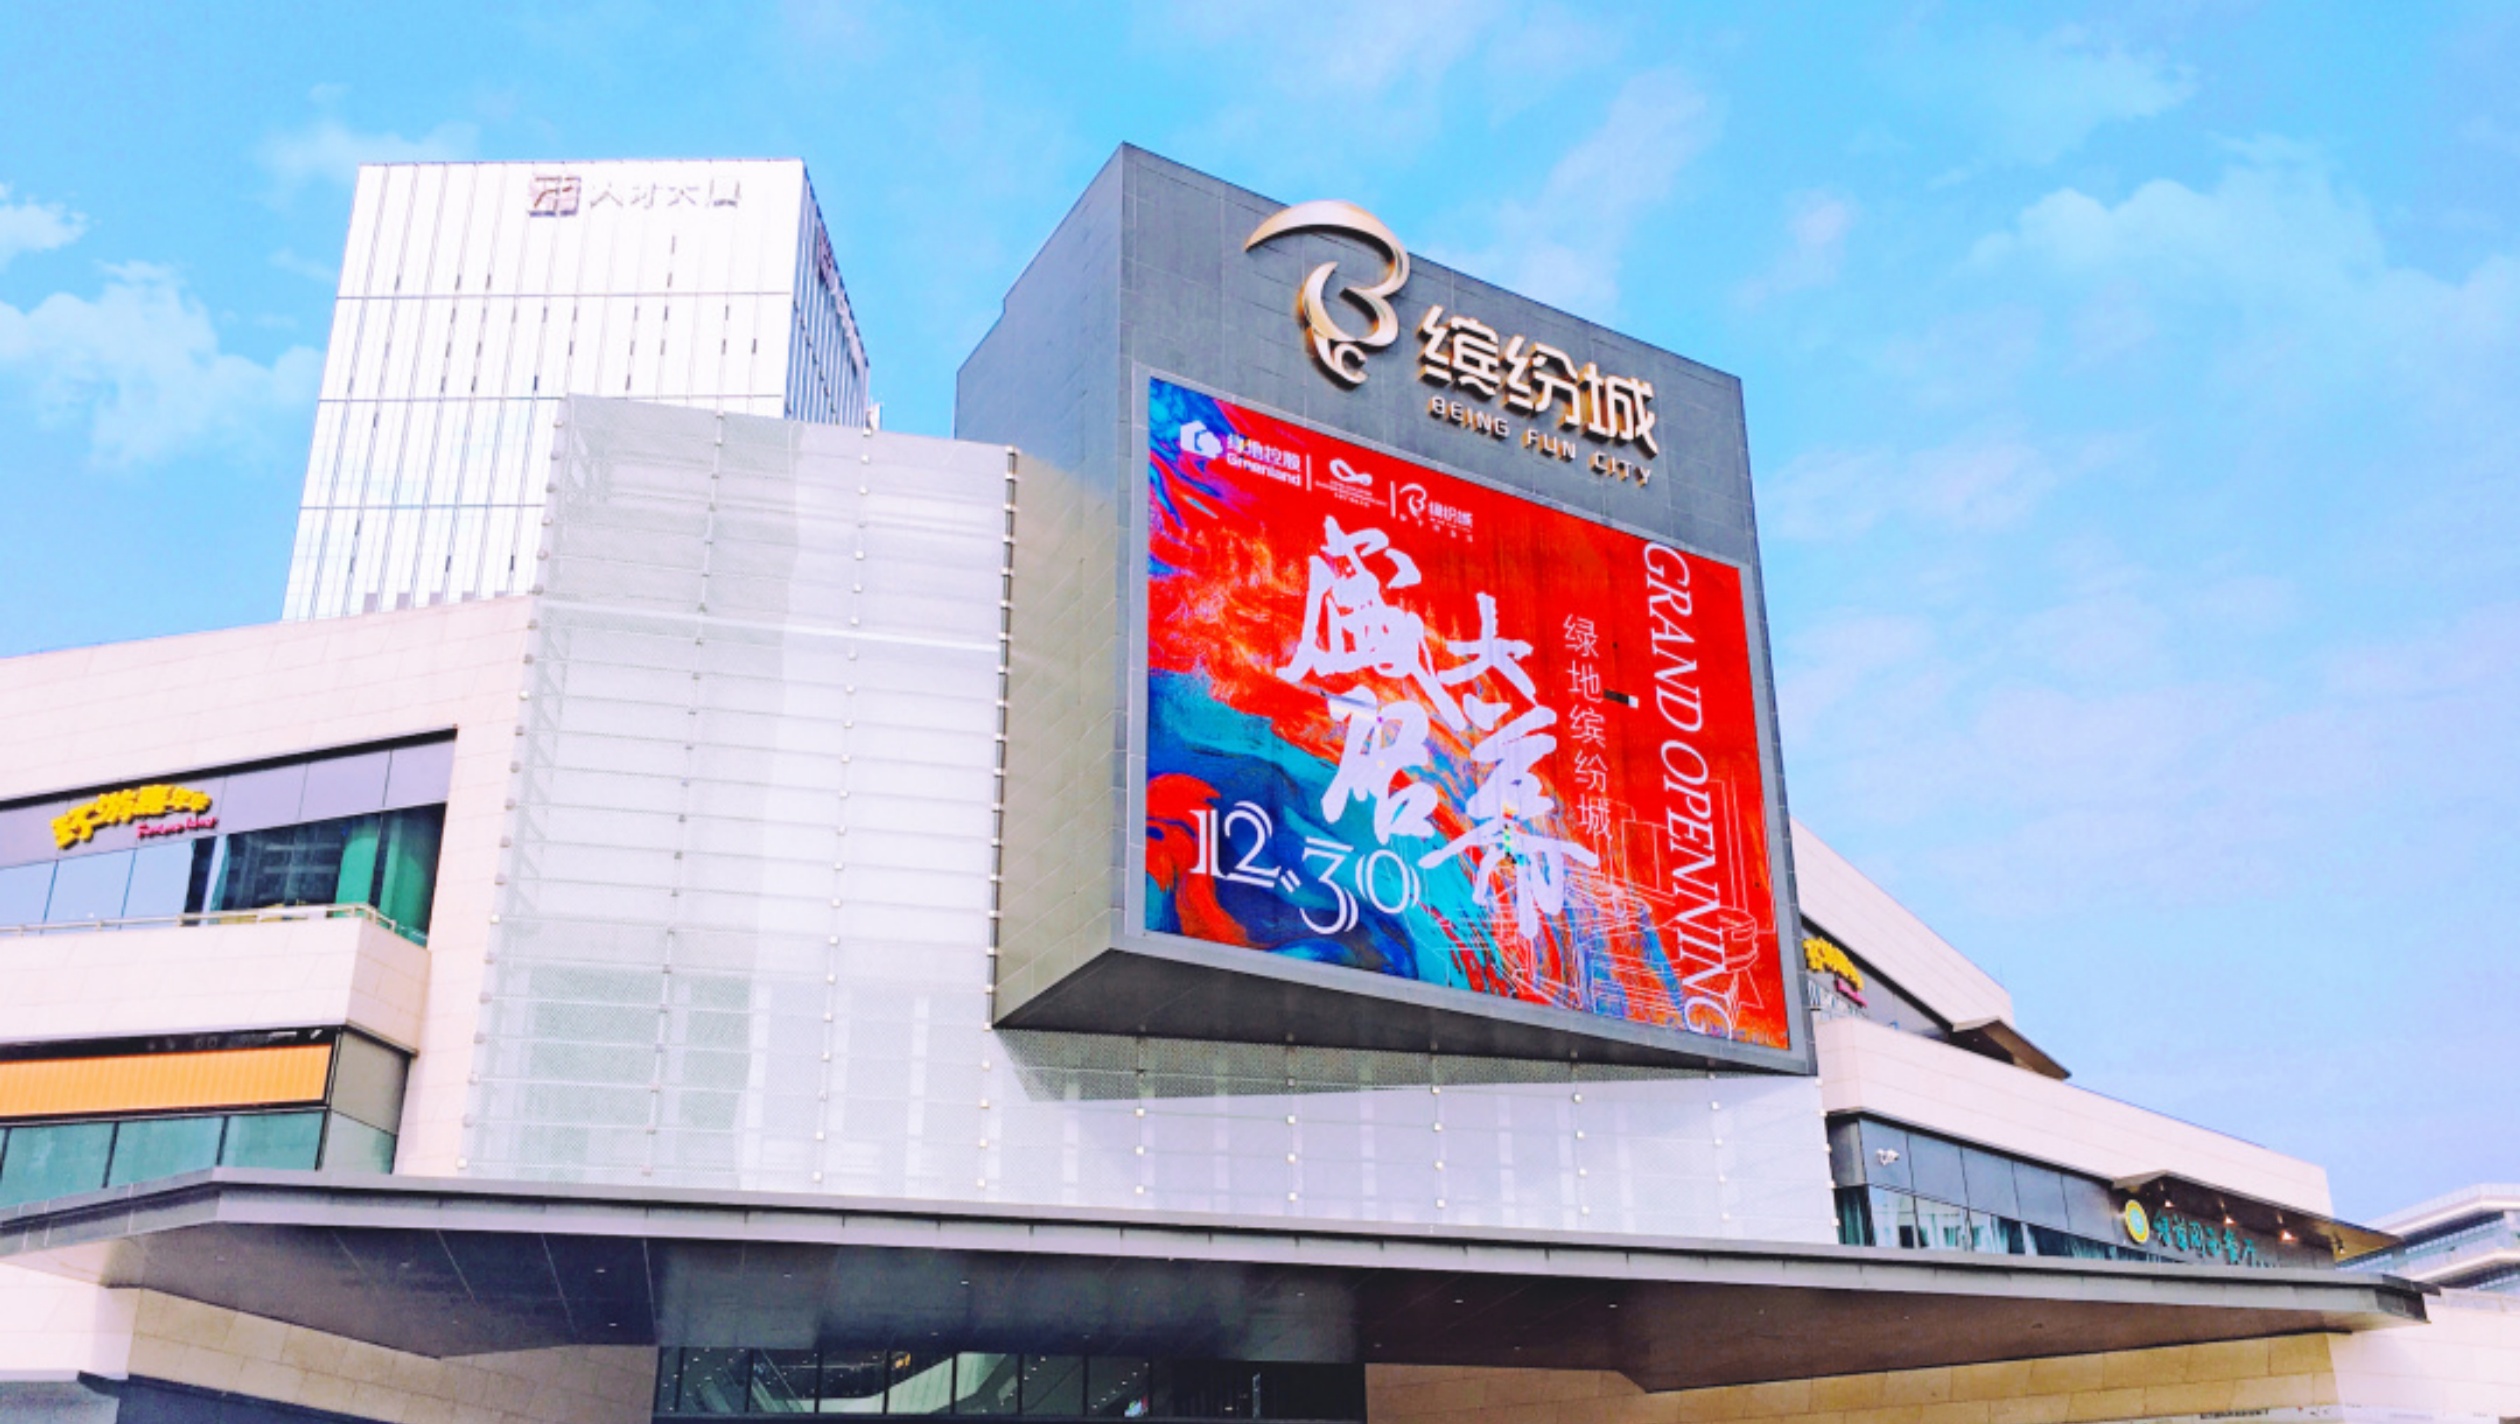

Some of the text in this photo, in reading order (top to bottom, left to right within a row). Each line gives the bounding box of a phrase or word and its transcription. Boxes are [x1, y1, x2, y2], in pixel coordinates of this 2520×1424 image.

[1416, 304, 1659, 458] 缤纷城
[1429, 395, 1651, 488] BEING FUN CITY
[1562, 613, 1613, 842] 绿地缤纷城
[1643, 540, 1733, 1040] GRAND OPENNING
